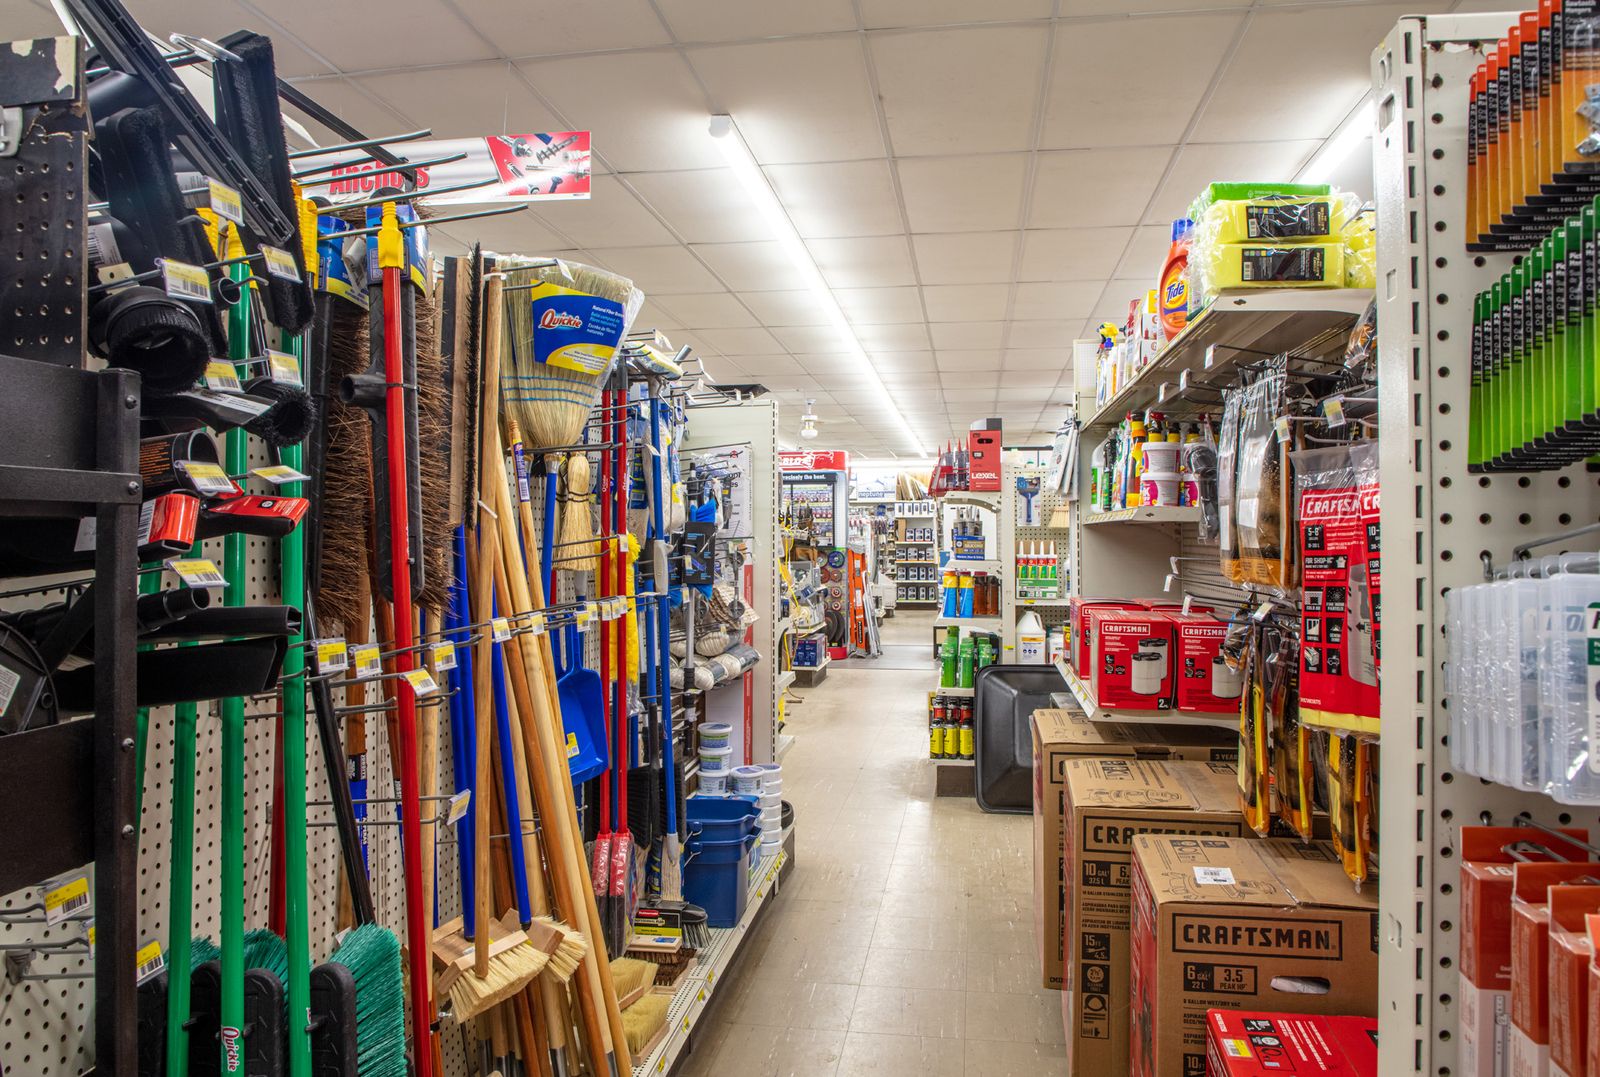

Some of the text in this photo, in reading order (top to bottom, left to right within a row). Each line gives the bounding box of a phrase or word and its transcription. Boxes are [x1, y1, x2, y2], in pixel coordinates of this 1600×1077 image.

[329, 159, 430, 194] Anchos
[1166, 281, 1185, 303] Tide
[538, 308, 583, 330] Quickie
[1105, 625, 1147, 633] CRAFTSMAN
[1084, 863, 1096, 876] 10
[1084, 934, 1095, 946] 15
[1183, 923, 1330, 950] CRAFTSMAN
[1187, 965, 1196, 980] 6
[1223, 969, 1244, 983] 3.5
[1191, 981, 1200, 989] 22
[221, 1026, 240, 1072] Quickie
[1186, 1056, 1199, 1069] 10
